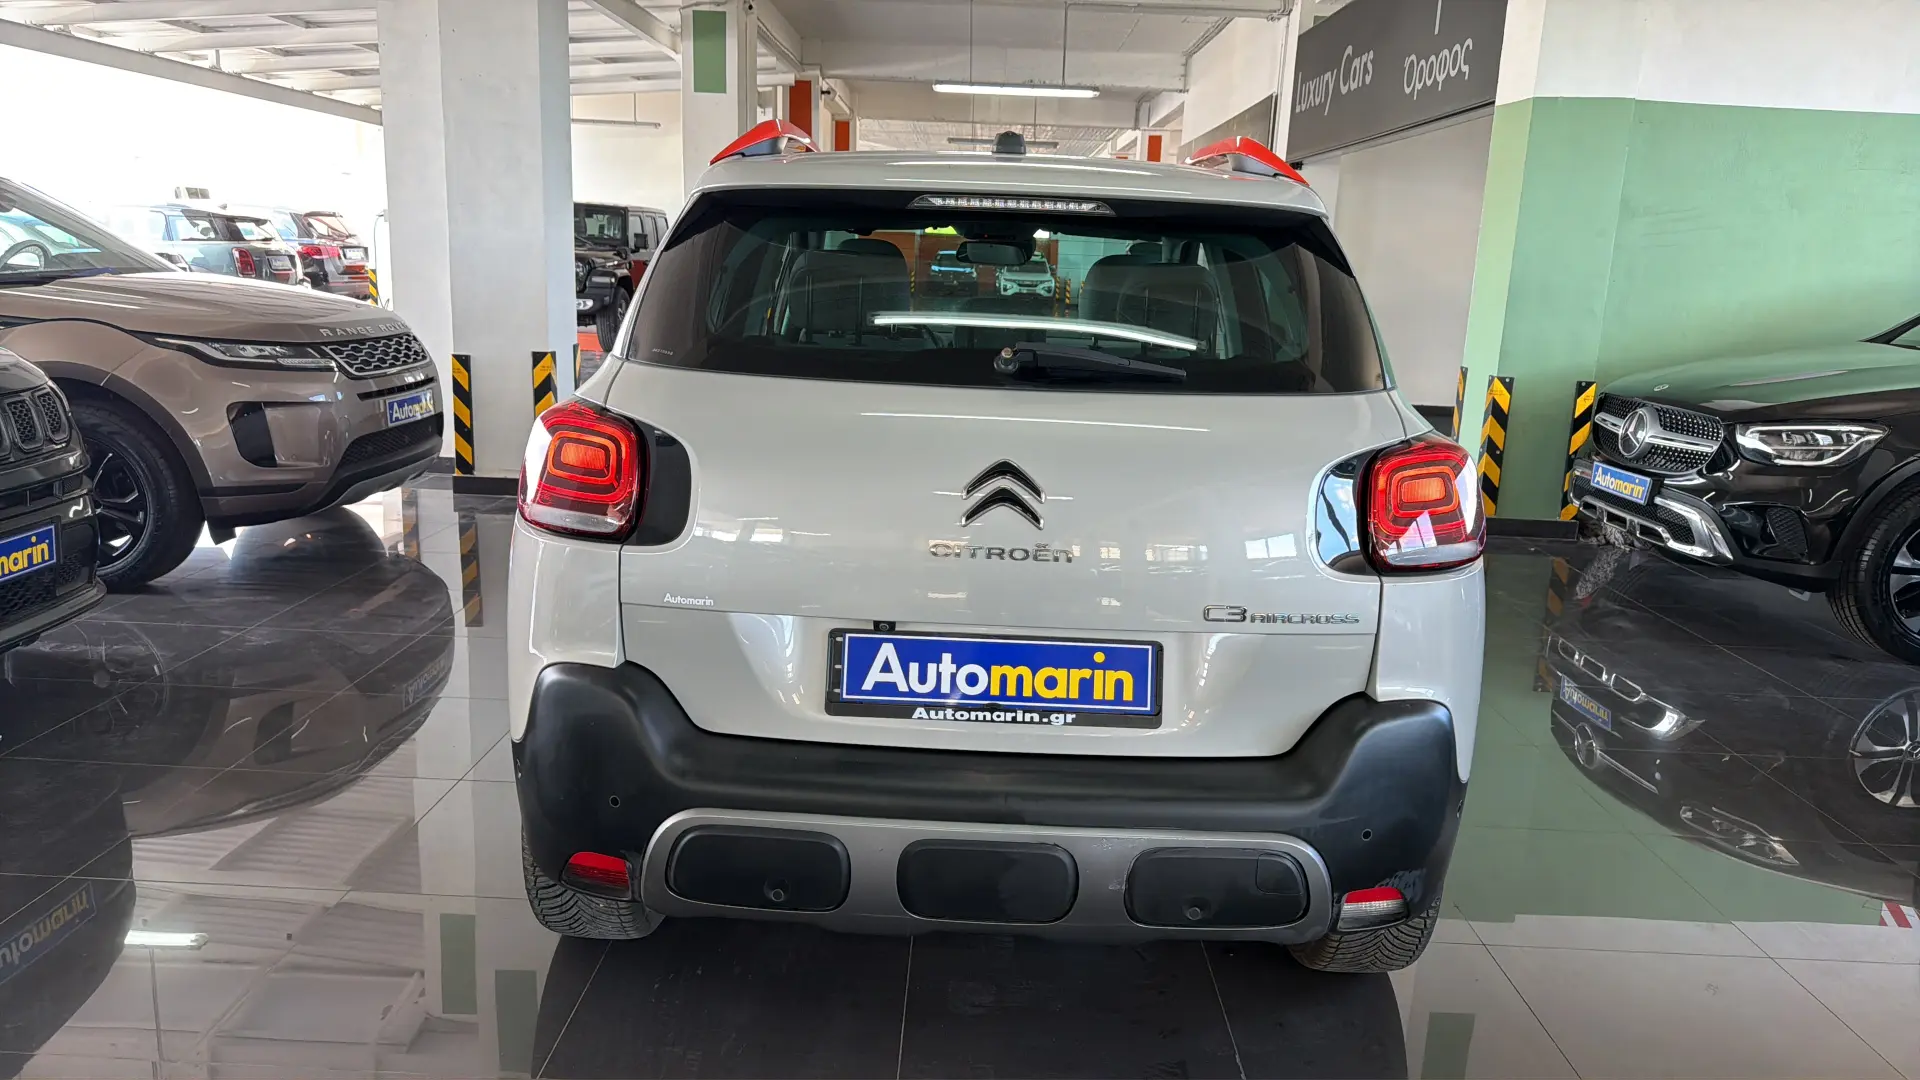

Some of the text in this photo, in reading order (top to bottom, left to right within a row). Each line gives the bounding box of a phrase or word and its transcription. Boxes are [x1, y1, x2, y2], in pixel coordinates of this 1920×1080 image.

[1295, 45, 1374, 116] Luxury Cars
[319, 326, 376, 337] RANGE
[1594, 466, 1645, 499] Automarin
[663, 592, 714, 606] Automarin
[1203, 604, 1360, 625] C3 AIRCROSS
[861, 642, 1134, 702] Automarin
[911, 706, 1077, 726] Automarin.gr
